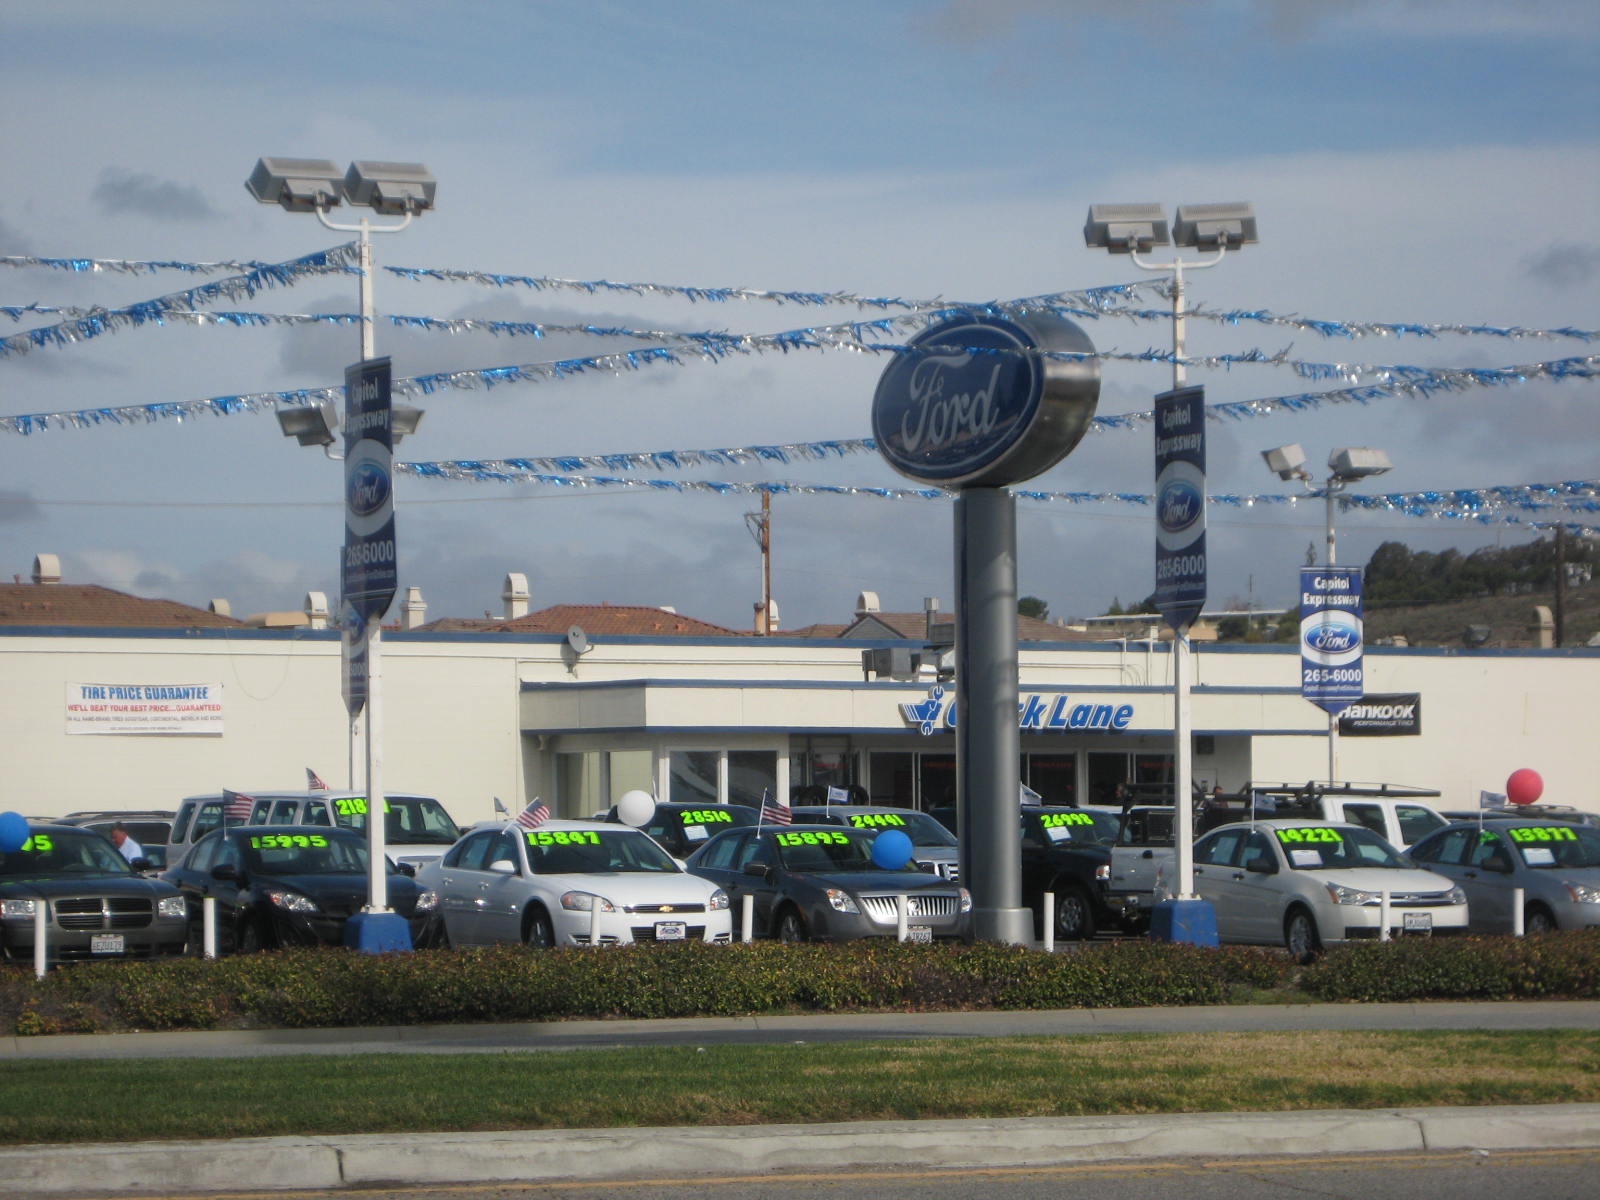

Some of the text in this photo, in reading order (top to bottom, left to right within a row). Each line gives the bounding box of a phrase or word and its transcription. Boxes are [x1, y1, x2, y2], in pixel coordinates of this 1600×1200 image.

[901, 353, 1001, 452] Ford
[351, 468, 380, 506] Ford
[1162, 488, 1191, 522] Ford
[1313, 576, 1350, 592] Capitol
[1303, 592, 1360, 608] Expressway
[1316, 626, 1351, 649] Ford
[1303, 669, 1362, 682] 265-6000
[81, 686, 208, 699] TIRE PRICE GUARANTEE
[1048, 695, 1135, 728] Lane
[1040, 814, 1094, 828] 26998
[250, 835, 328, 849] 15995
[526, 831, 601, 846] 15847
[776, 831, 849, 847] 15895
[1509, 827, 1577, 842] 13877
